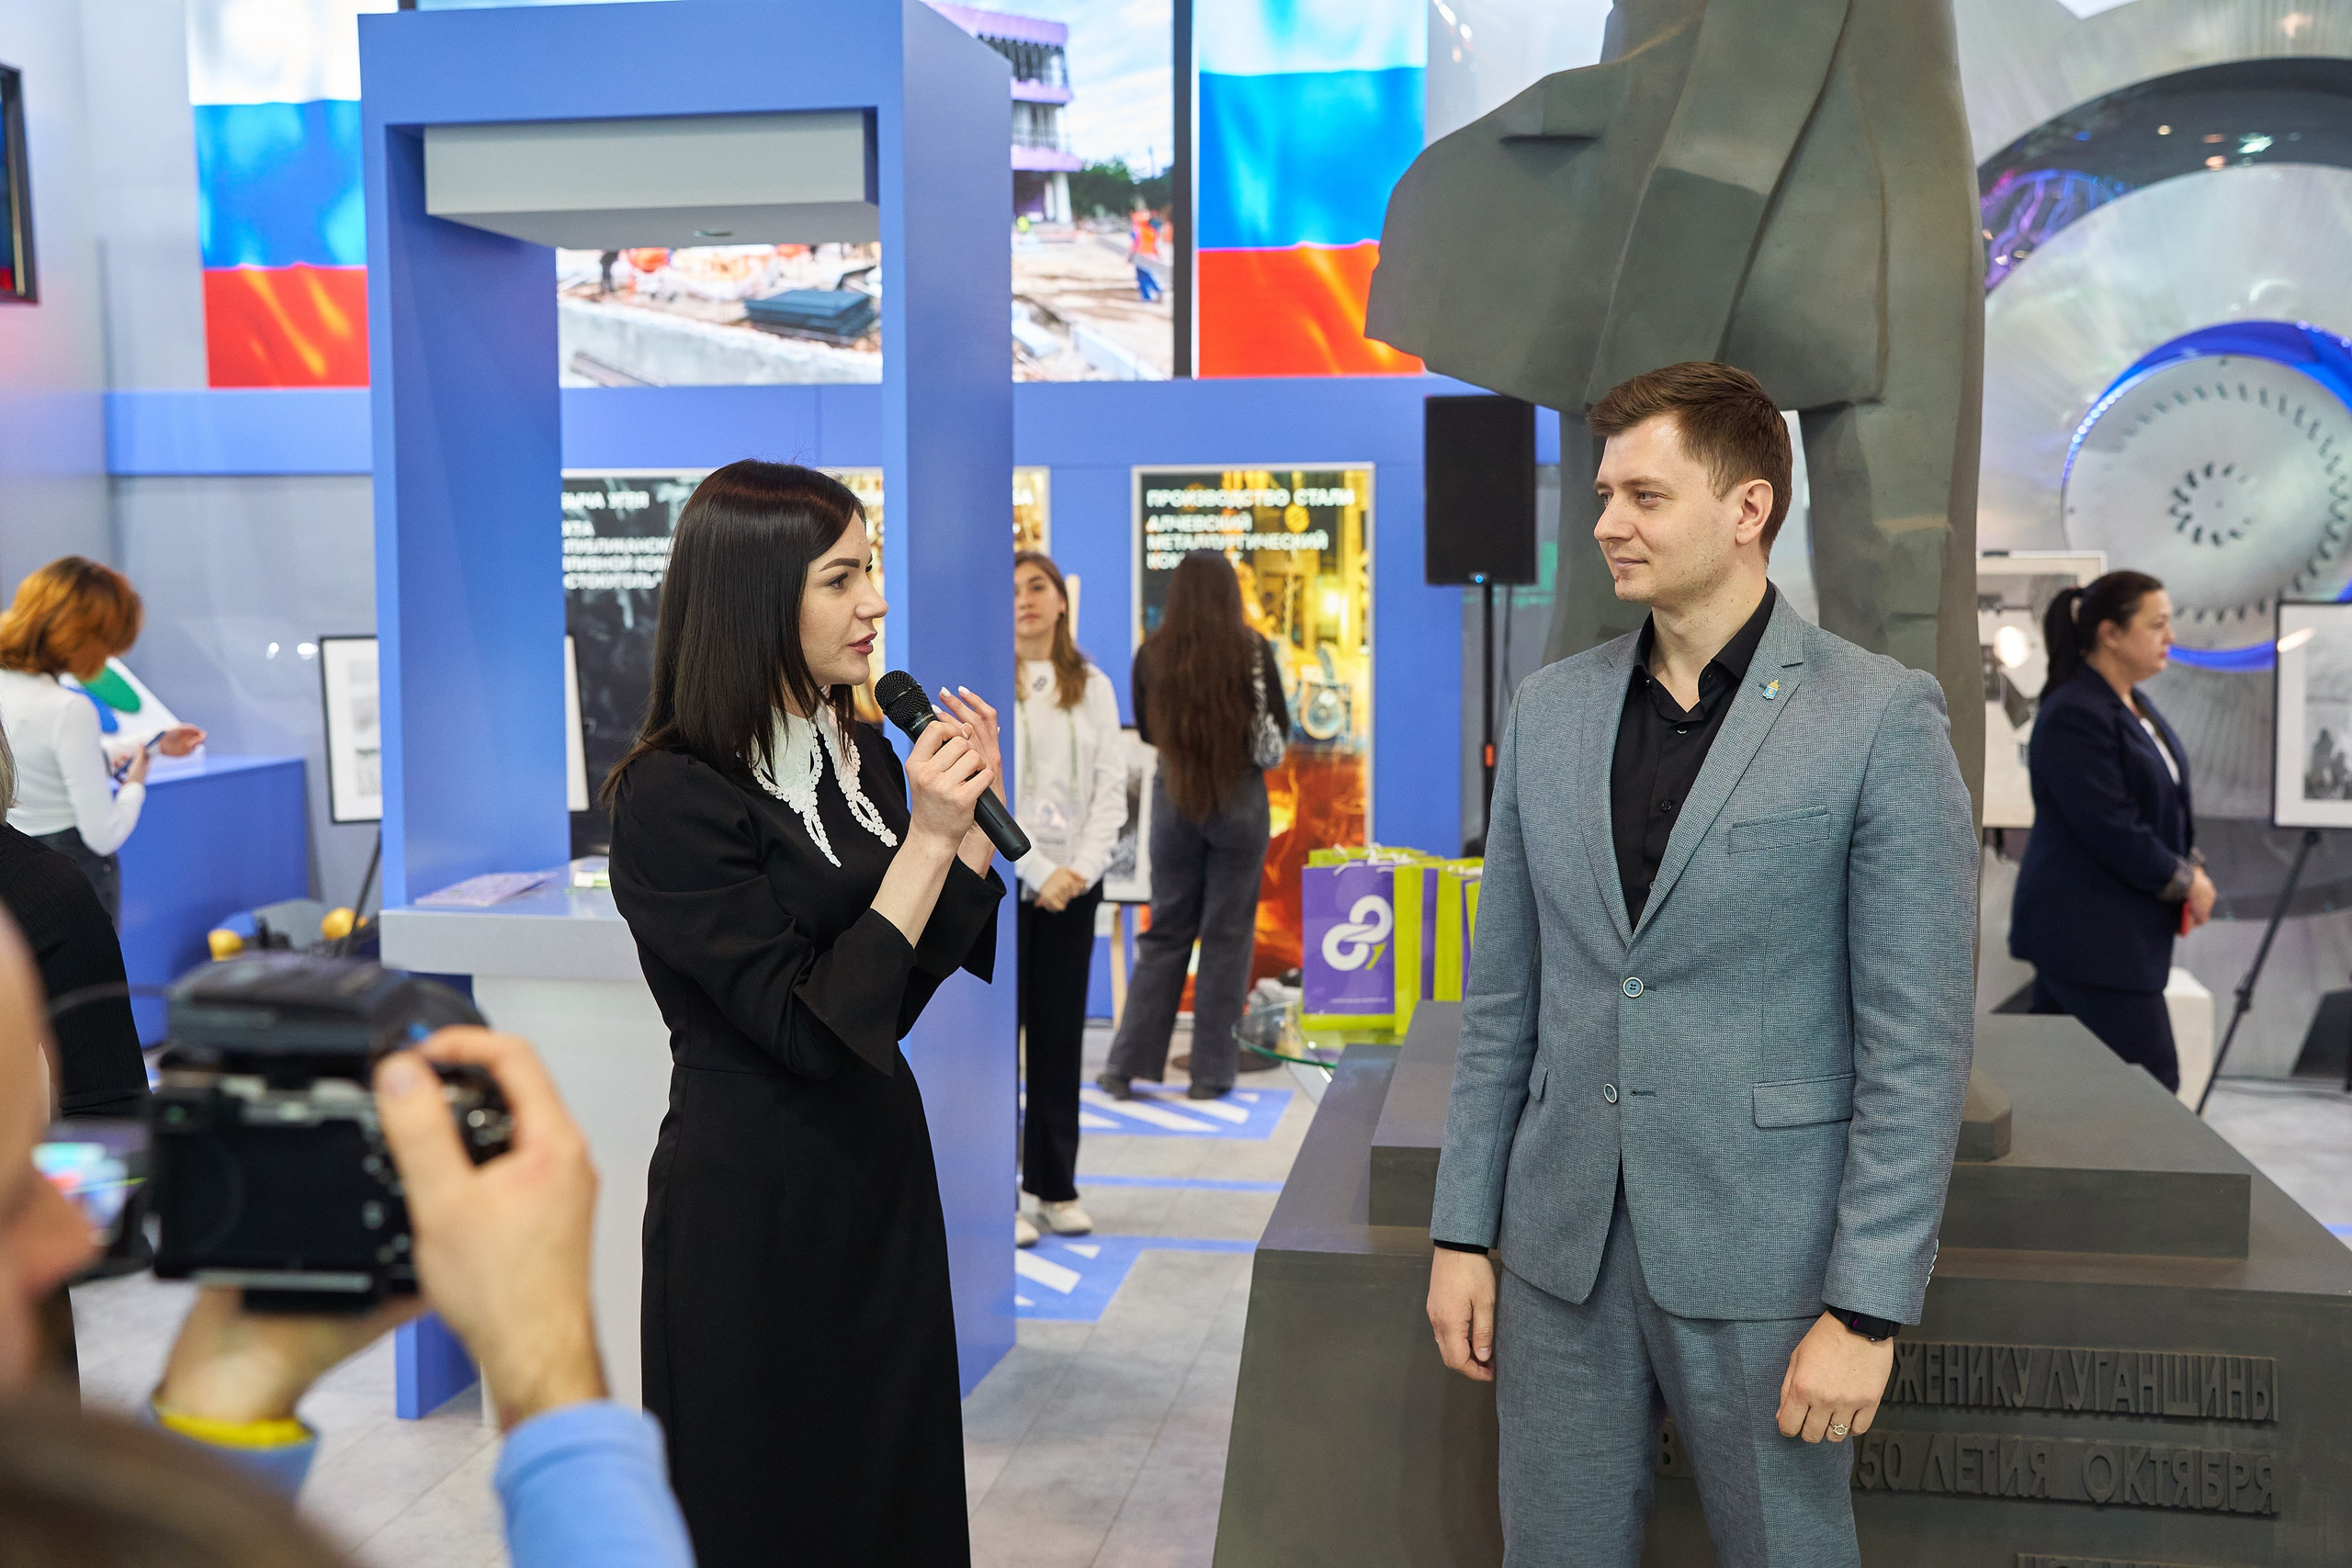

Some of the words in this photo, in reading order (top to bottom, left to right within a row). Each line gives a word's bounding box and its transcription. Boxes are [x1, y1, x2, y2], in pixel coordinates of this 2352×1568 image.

[1147, 489, 1290, 509] ПРОИЗВОДСТВО
[1293, 488, 1356, 507] СТАЛИ
[1146, 511, 1253, 532] АЛЧЕВСКИЙ
[1147, 529, 1329, 550] МЕТАЛЛУРГИЧЕСКИЙ
[1889, 1342, 2033, 1407] ЖЕНИКУ
[2042, 1348, 2278, 1421] ЛУГАНЩИНЫ
[1920, 1433, 2049, 1498] ЛЕТИЯ
[2081, 1442, 2278, 1515] ОКТЯБРЯ
